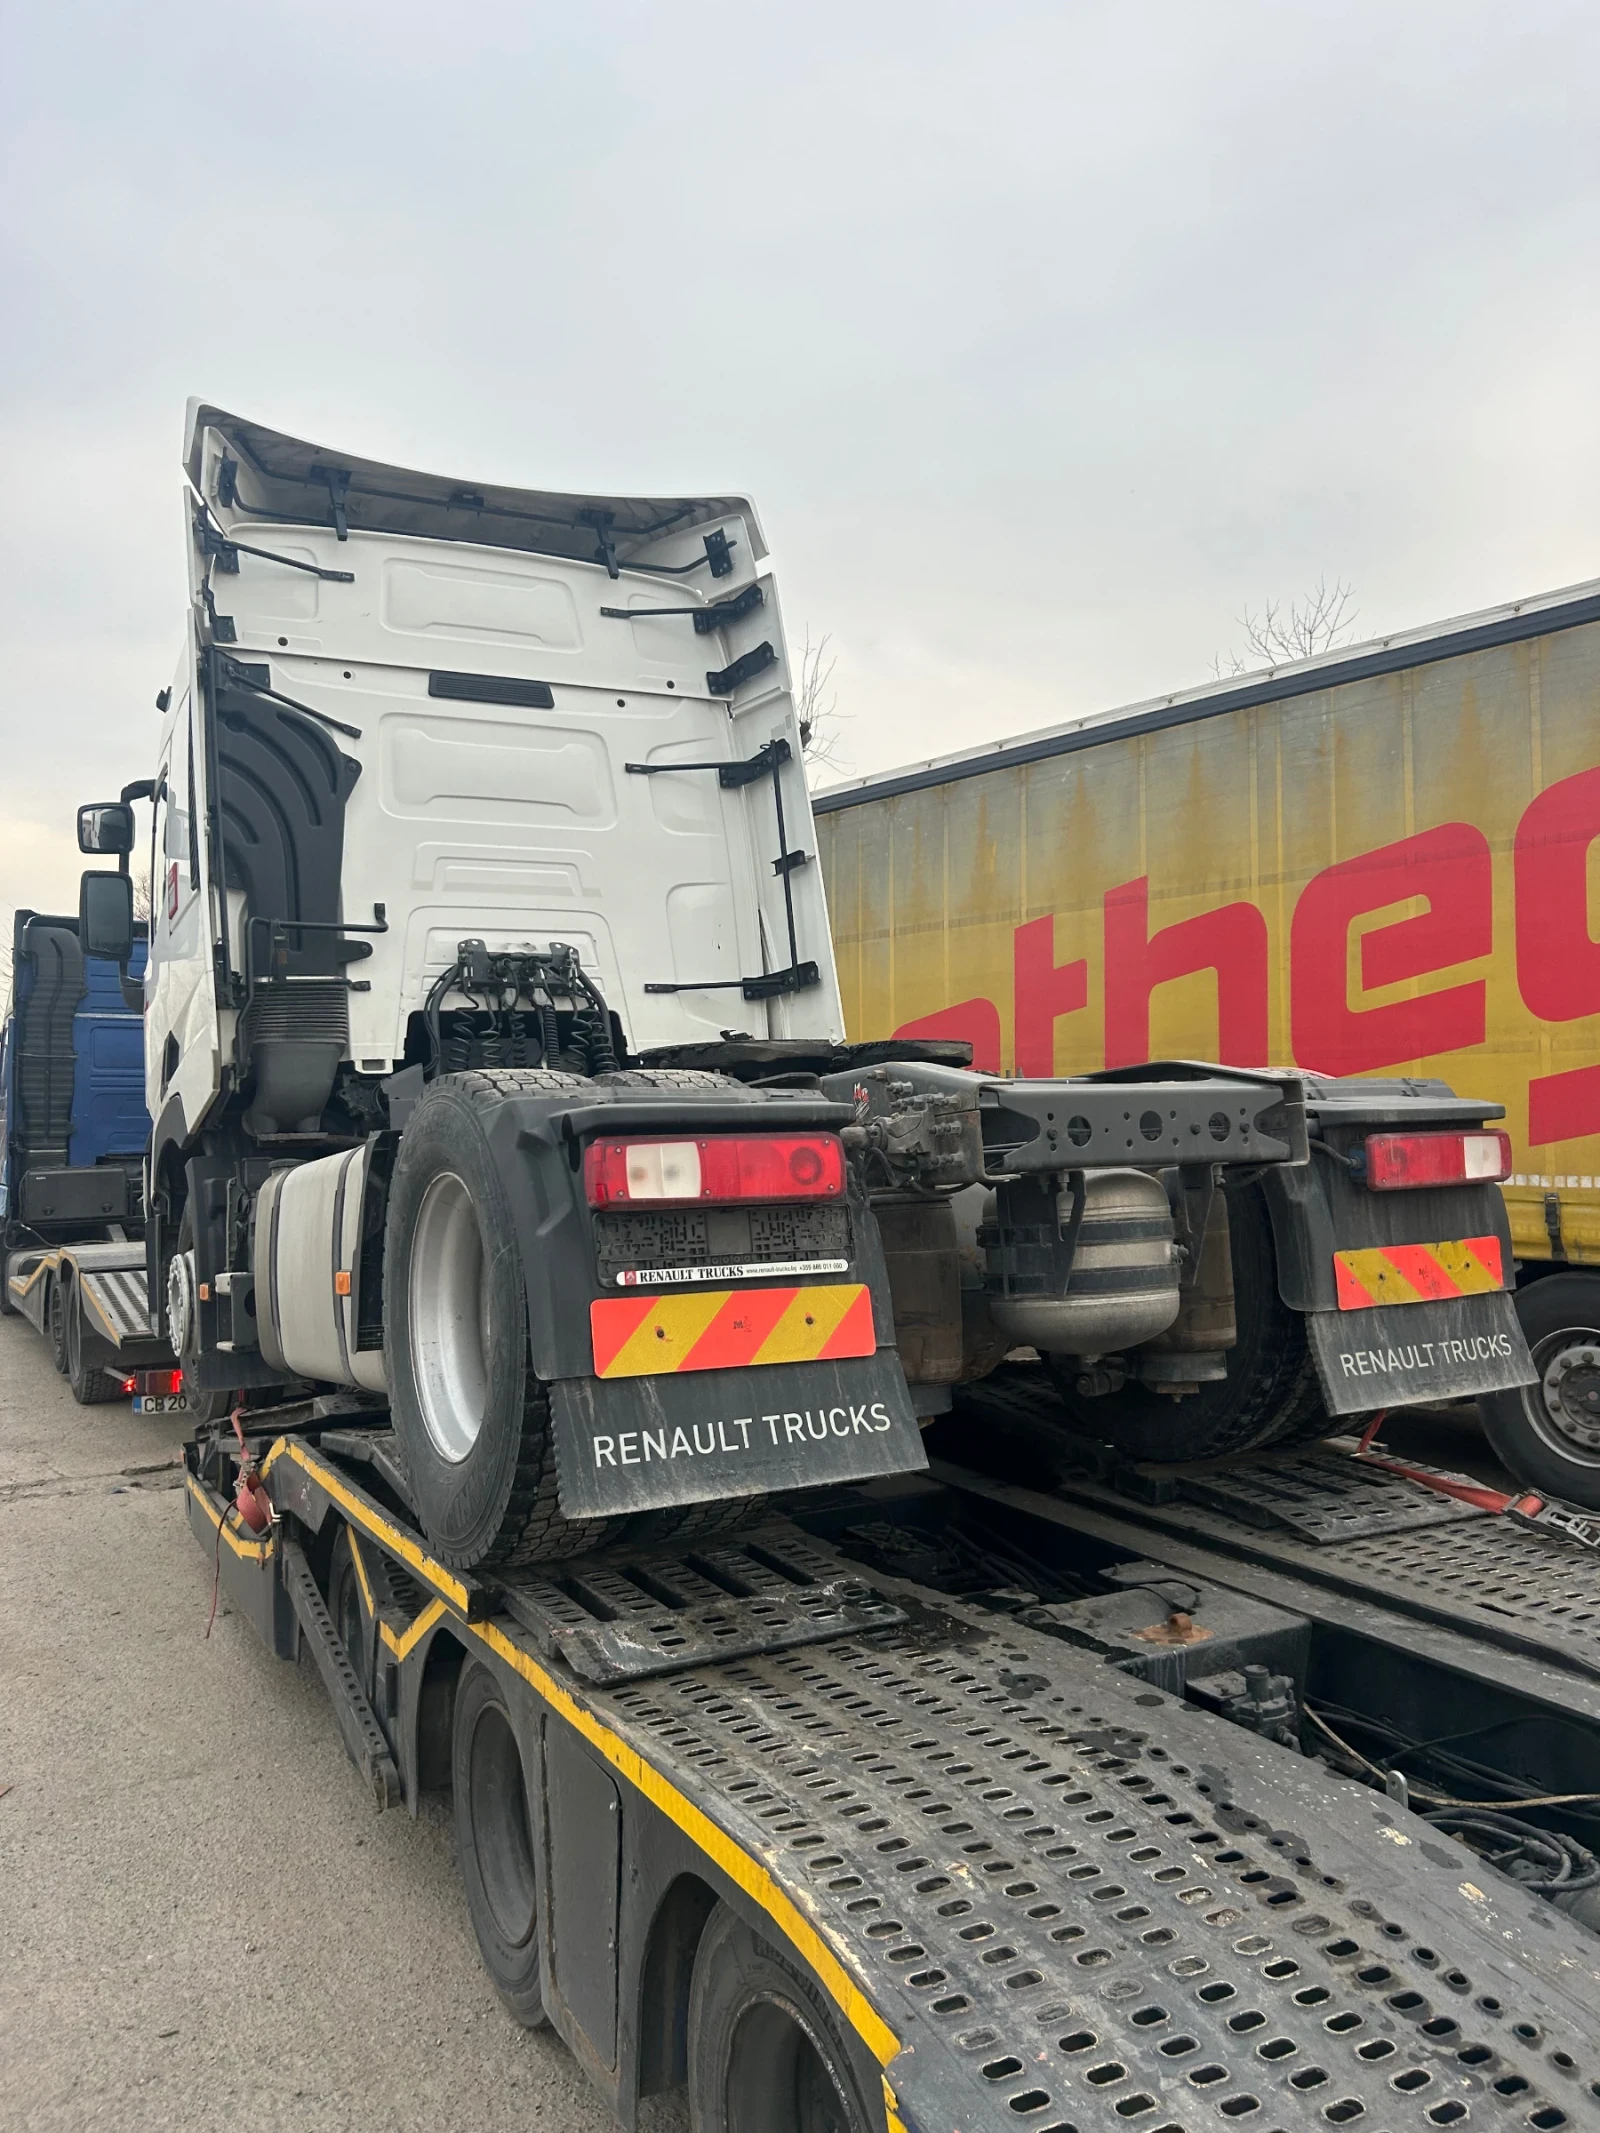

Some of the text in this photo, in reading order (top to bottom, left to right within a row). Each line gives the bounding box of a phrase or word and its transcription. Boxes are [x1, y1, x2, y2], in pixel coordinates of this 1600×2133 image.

[639, 1268, 694, 1283] RENAULT
[697, 1265, 744, 1279] TRUCKS
[1340, 1334, 1513, 1378] RENAULT TRUCKS
[593, 1417, 753, 1468] RENAULT
[762, 1402, 892, 1446] TRUCKS
